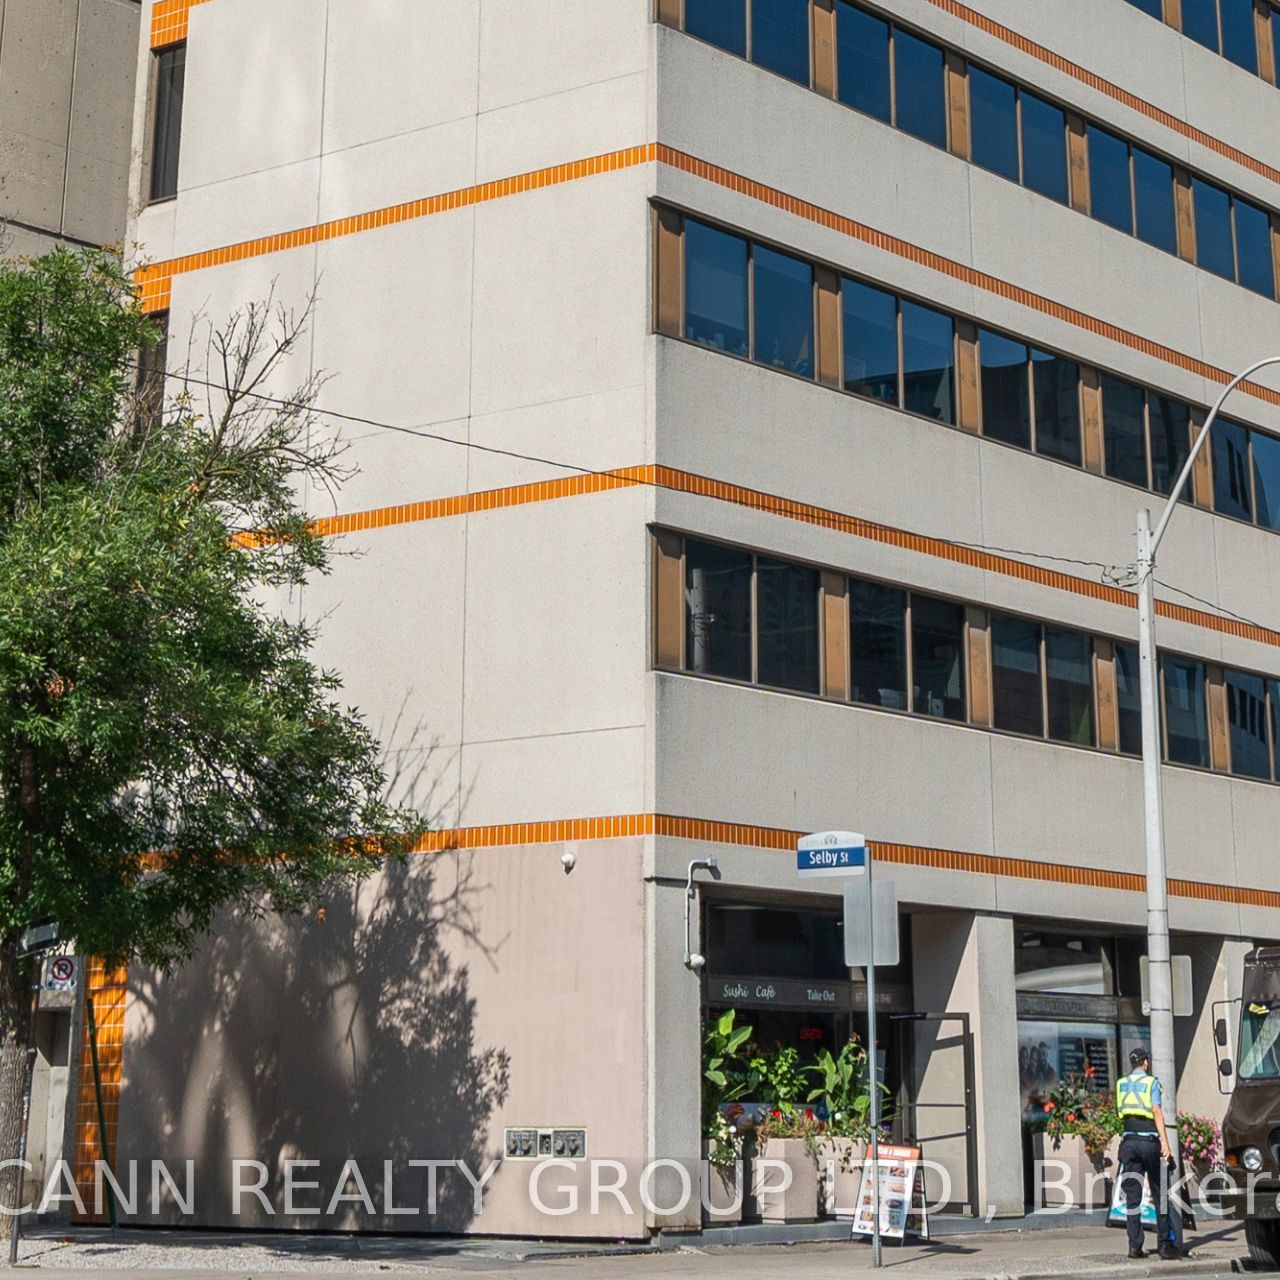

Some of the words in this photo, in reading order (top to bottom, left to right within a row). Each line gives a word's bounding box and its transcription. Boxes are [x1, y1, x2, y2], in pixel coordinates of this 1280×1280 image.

[809, 850, 838, 866] Selby
[840, 851, 849, 863] St
[723, 983, 749, 998] Sushi
[807, 989, 822, 1001] Take
[823, 990, 836, 1002] Out
